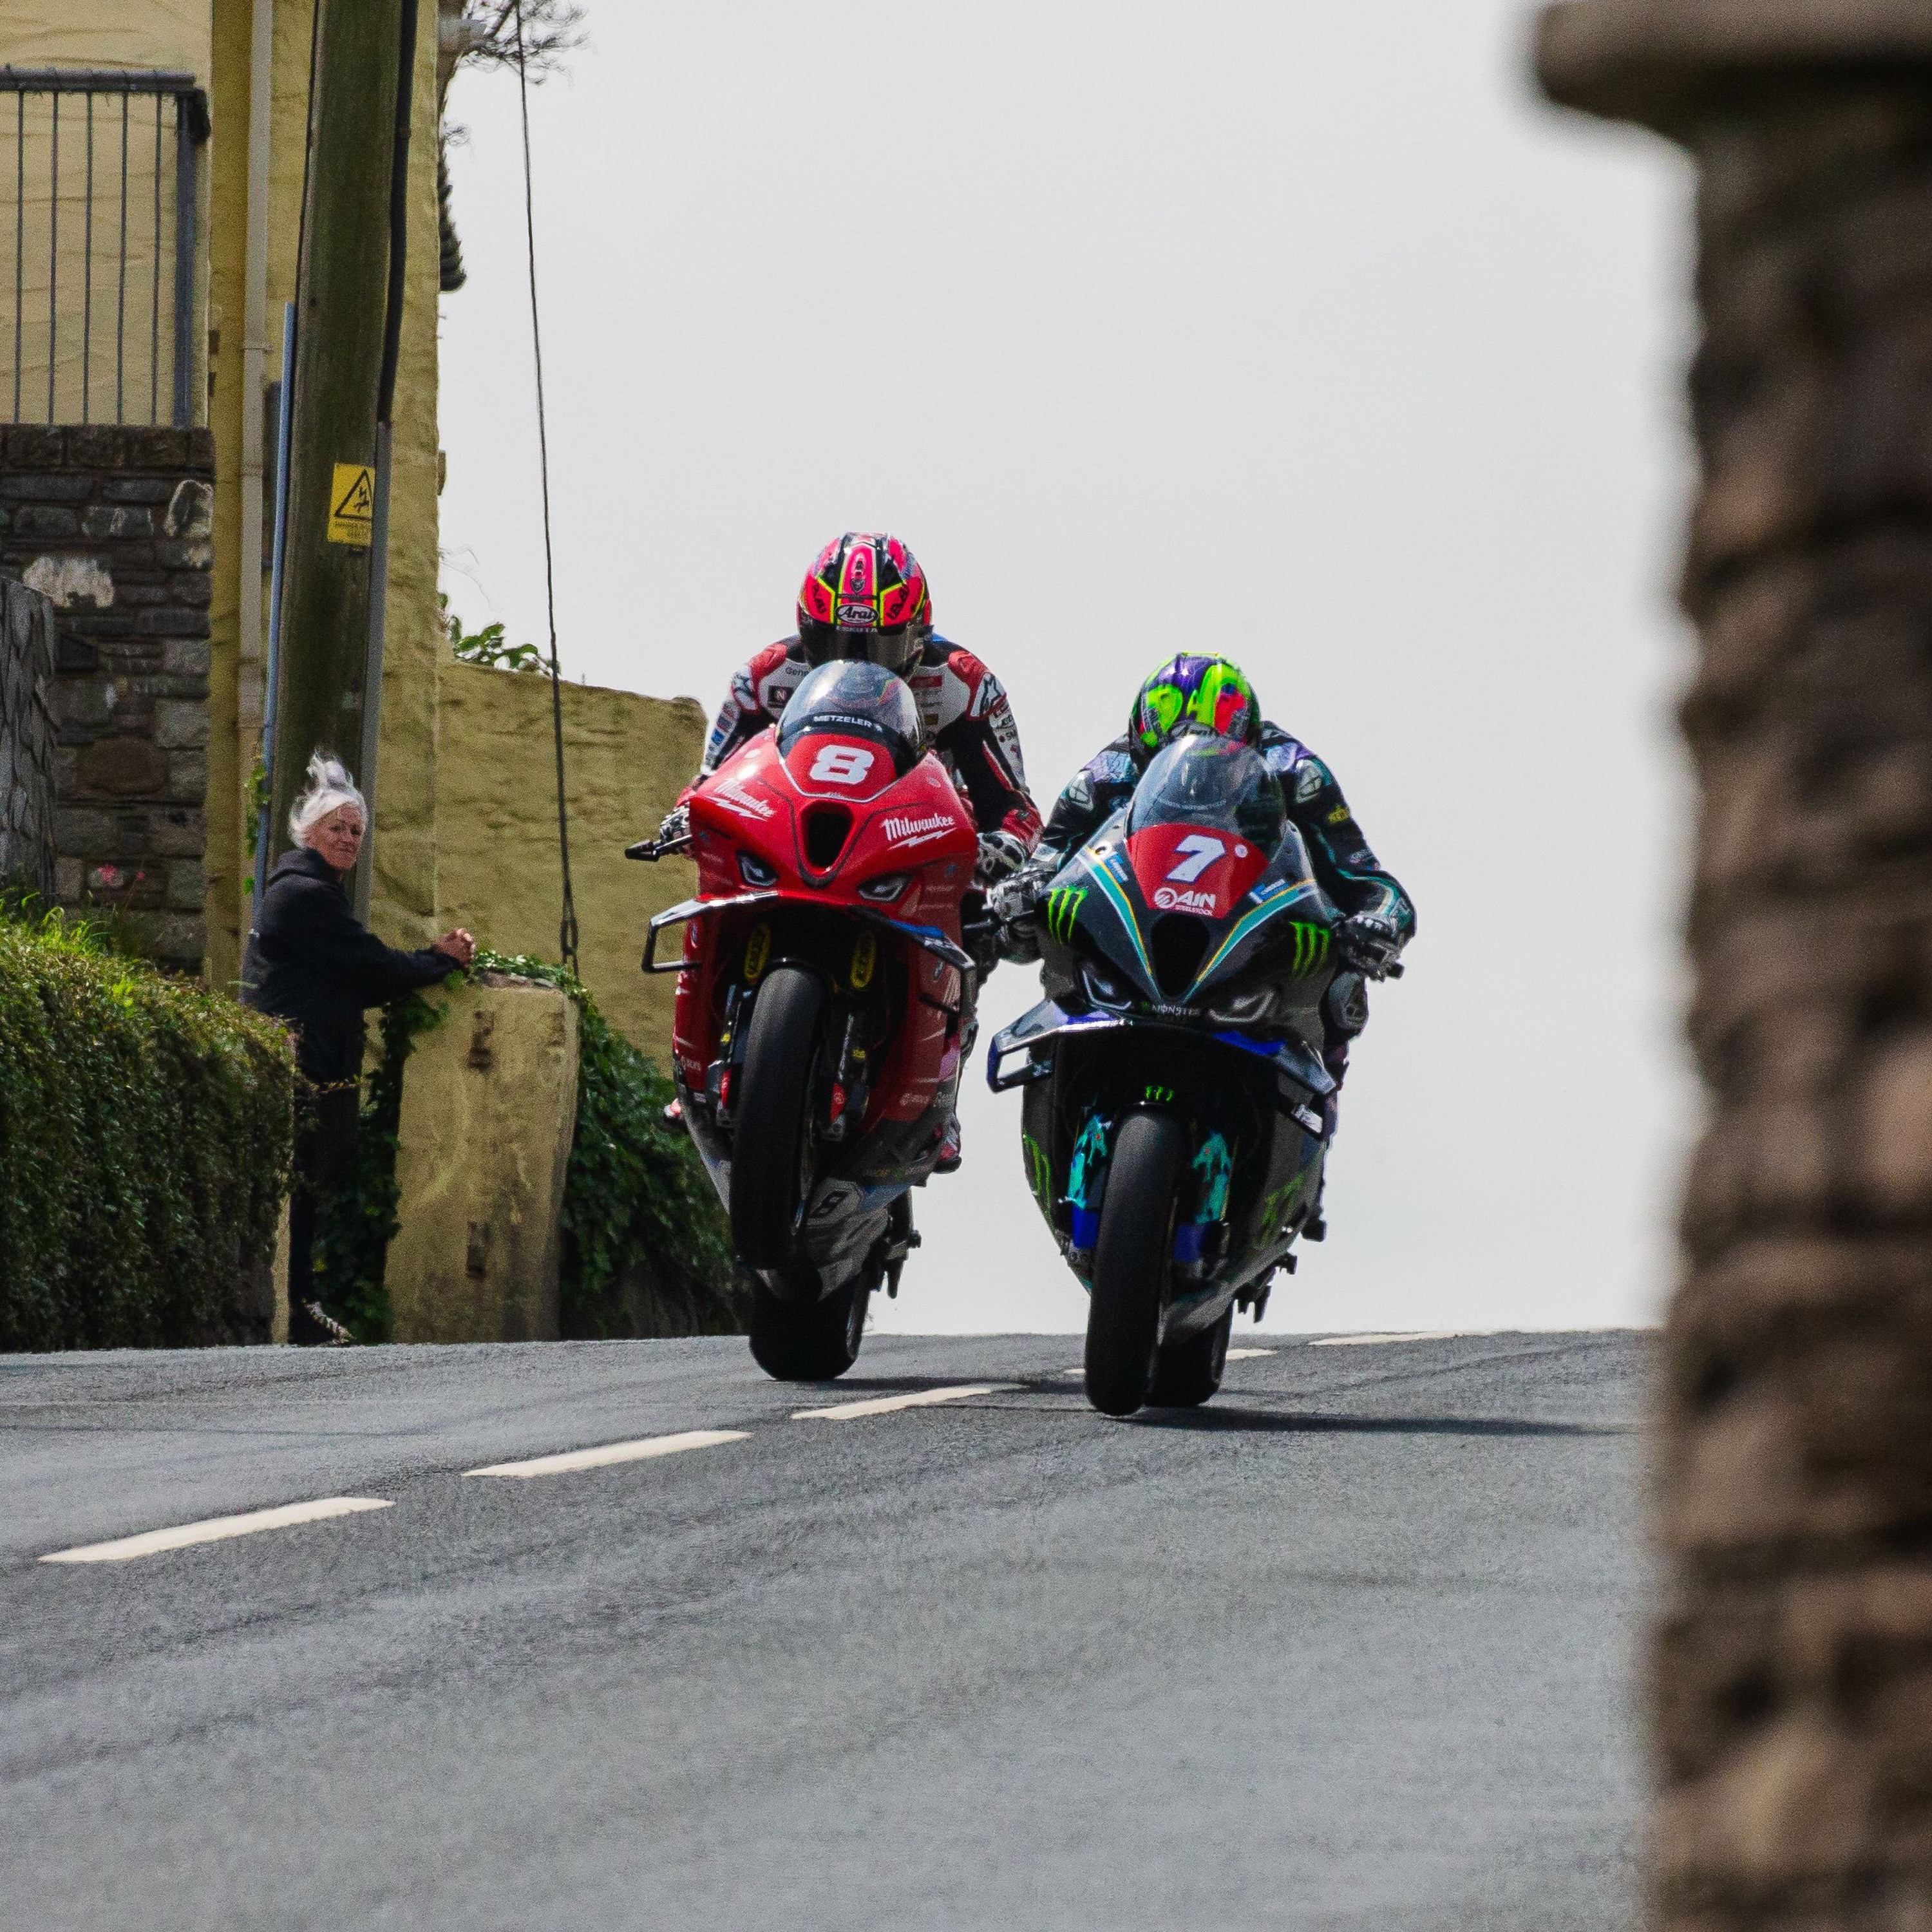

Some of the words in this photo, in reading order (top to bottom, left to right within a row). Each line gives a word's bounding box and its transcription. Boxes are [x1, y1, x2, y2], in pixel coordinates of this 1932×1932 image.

[838, 605, 873, 620] Arai
[813, 715, 873, 728] METZELER
[810, 744, 875, 785] 8
[712, 778, 777, 817] Milwaukee
[879, 812, 956, 842] Milwaukee
[1164, 835, 1226, 883] 7
